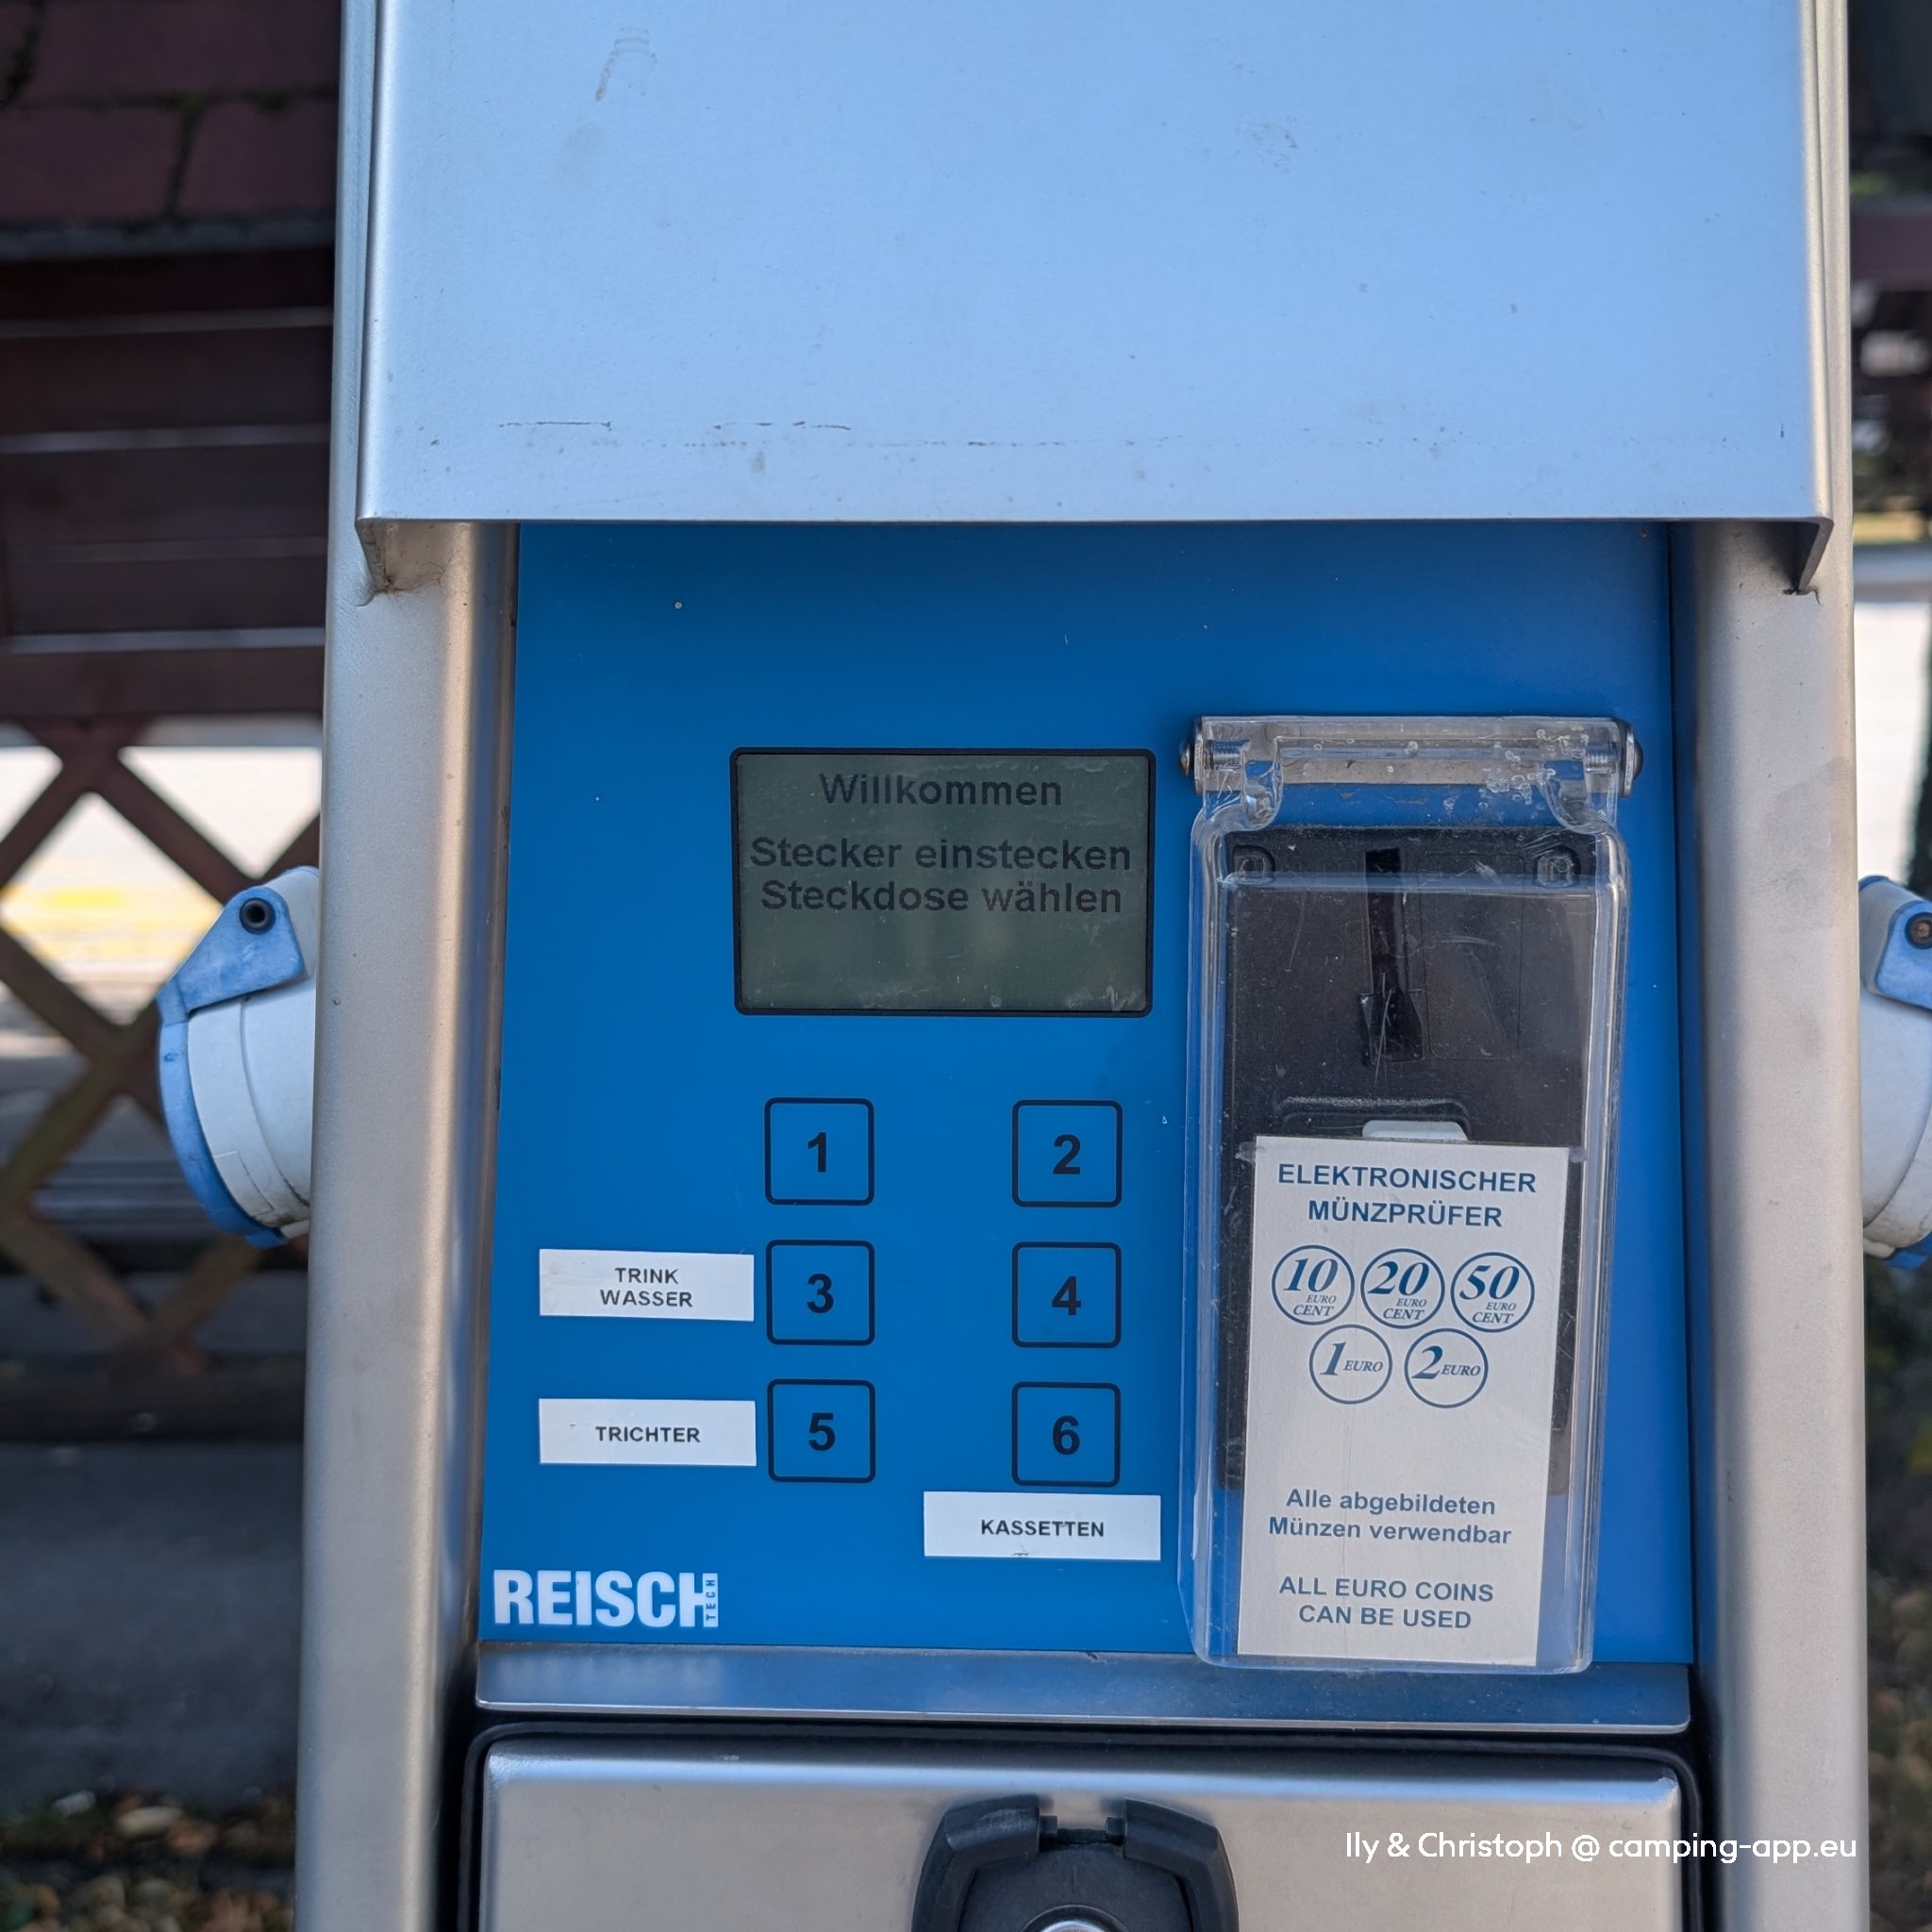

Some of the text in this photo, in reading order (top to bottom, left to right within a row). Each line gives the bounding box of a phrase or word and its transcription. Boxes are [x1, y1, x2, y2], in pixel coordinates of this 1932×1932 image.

[819, 774, 1062, 806] Willkommen
[749, 837, 1131, 871] Stecker einstecken
[760, 880, 1123, 913] Steckdose wählen
[806, 1132, 828, 1173] 1
[1052, 1135, 1082, 1175] 2
[1277, 1163, 1537, 1193] ELEKTRONISCHER
[1308, 1196, 1503, 1227] MÜNZPRÜFER
[614, 1267, 679, 1285] TRINK
[1283, 1257, 1339, 1292] 10
[1367, 1260, 1430, 1296] 20
[1458, 1264, 1521, 1300] 50
[599, 1289, 693, 1307] WASSER
[806, 1273, 835, 1314] 3
[1051, 1276, 1082, 1316] 4
[1306, 1294, 1337, 1305] EURO
[1396, 1297, 1427, 1308] EURO
[1485, 1301, 1517, 1312] EURO
[1292, 1304, 1335, 1317] CENT
[1382, 1307, 1425, 1321] CENT
[1472, 1311, 1514, 1324] CENT
[1320, 1341, 1384, 1376] 1 EURO
[1411, 1345, 1482, 1380] 2 EURO
[595, 1424, 701, 1444] TRICHTER
[807, 1412, 836, 1452] 5
[1052, 1415, 1081, 1456] 6
[1286, 1488, 1496, 1515] Alle abgebildeten
[980, 1518, 1105, 1538] KASSETTEN
[1269, 1516, 1512, 1544] Münzen verwendbar
[493, 1569, 719, 1628] REISCH
[706, 1578, 717, 1622] TECH
[1278, 1575, 1493, 1602] ALL EURO COINS
[1298, 1604, 1472, 1629] CAN BE USED
